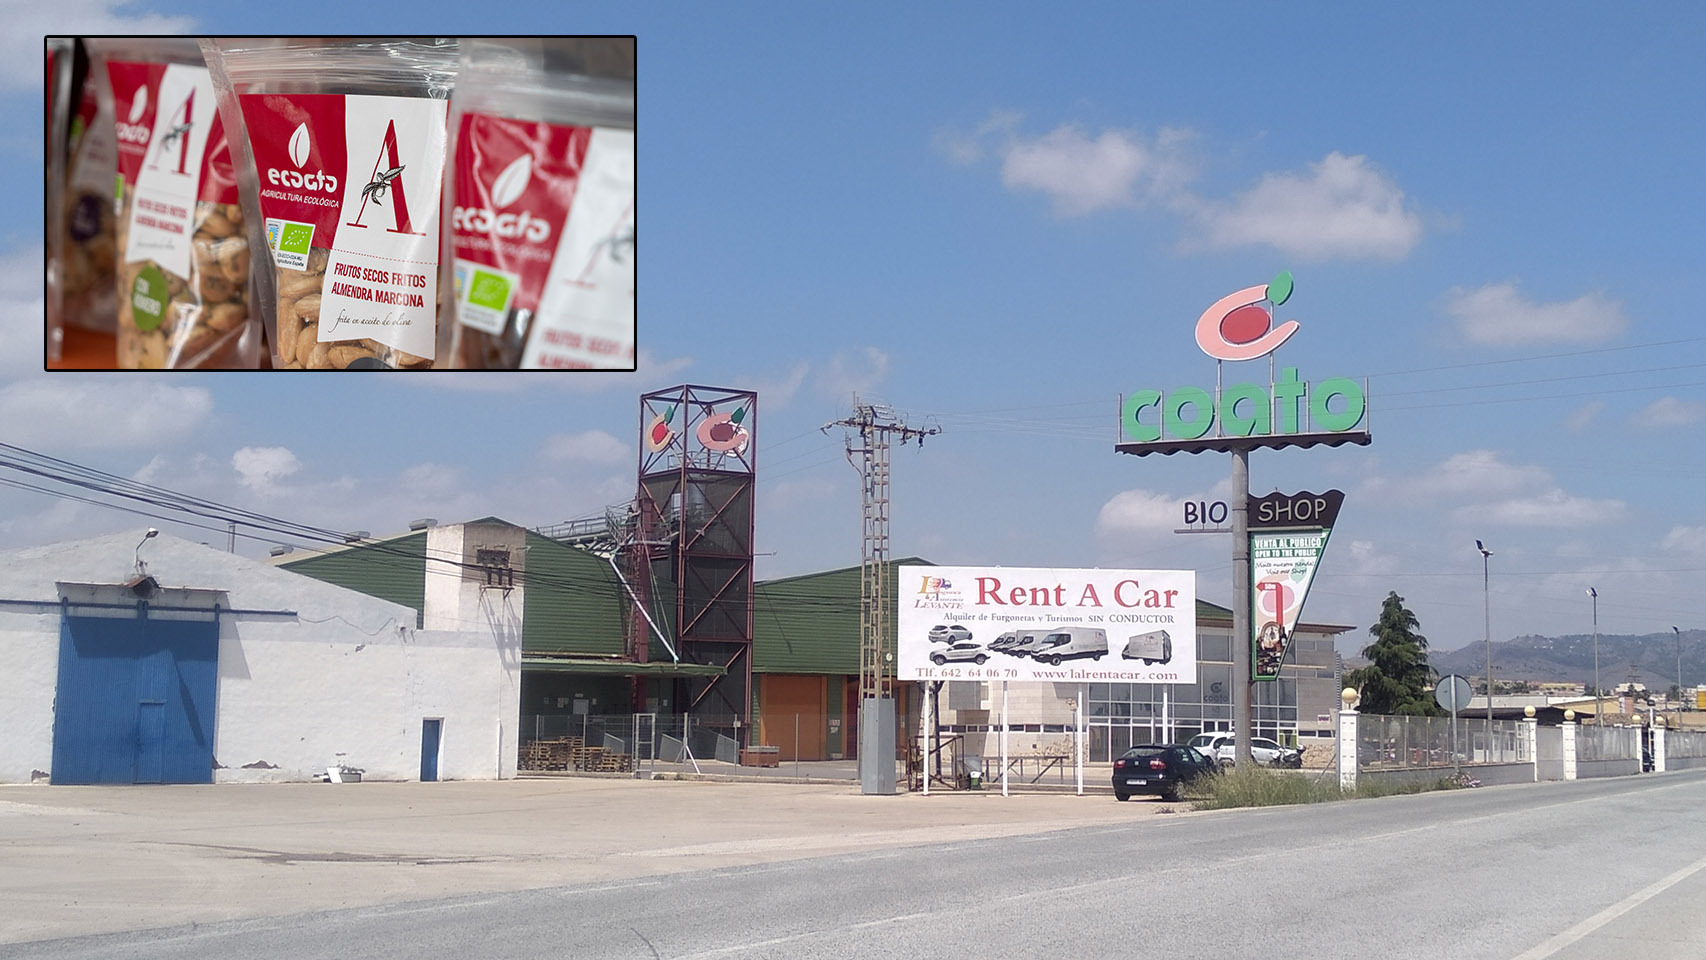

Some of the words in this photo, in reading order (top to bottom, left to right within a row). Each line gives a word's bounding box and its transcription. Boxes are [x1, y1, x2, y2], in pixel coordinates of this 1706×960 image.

[261, 189, 303, 203] AGRICULTURA
[303, 196, 339, 208] ECOLÓGICA
[333, 262, 362, 279] FRUTOS
[362, 267, 389, 284] SECOS
[391, 272, 426, 288] FRITOS
[331, 281, 373, 302] ALMENDRA
[375, 289, 424, 308] MARCONA
[361, 316, 380, 325] aceite
[382, 311, 392, 326] de
[392, 312, 413, 326] oliva
[1122, 366, 1366, 442] coato
[1184, 501, 1228, 524] BIO
[1258, 499, 1326, 522] SHOP
[1255, 539, 1277, 549] VENTA
[1279, 538, 1288, 548] AL
[1255, 550, 1271, 558] OPEN
[1272, 549, 1280, 557] TO
[1281, 549, 1293, 557] THE
[1294, 548, 1317, 557] PUBLIC
[974, 577, 1067, 607] Rent
[1076, 583, 1103, 608] A
[1114, 579, 1179, 609] Car
[914, 599, 964, 609] LEVANTE
[943, 612, 975, 622] Alquiler
[978, 612, 988, 621] de
[991, 613, 1035, 623] Furgonetas
[1045, 614, 1083, 623] Turismos
[1088, 615, 1104, 623] SIN
[1109, 614, 1175, 624] CONDUCTOR
[915, 667, 937, 678] Tlf.
[941, 668, 961, 678] 642
[968, 668, 981, 678] 64
[986, 668, 999, 678] 06
[1004, 668, 1018, 678] 70
